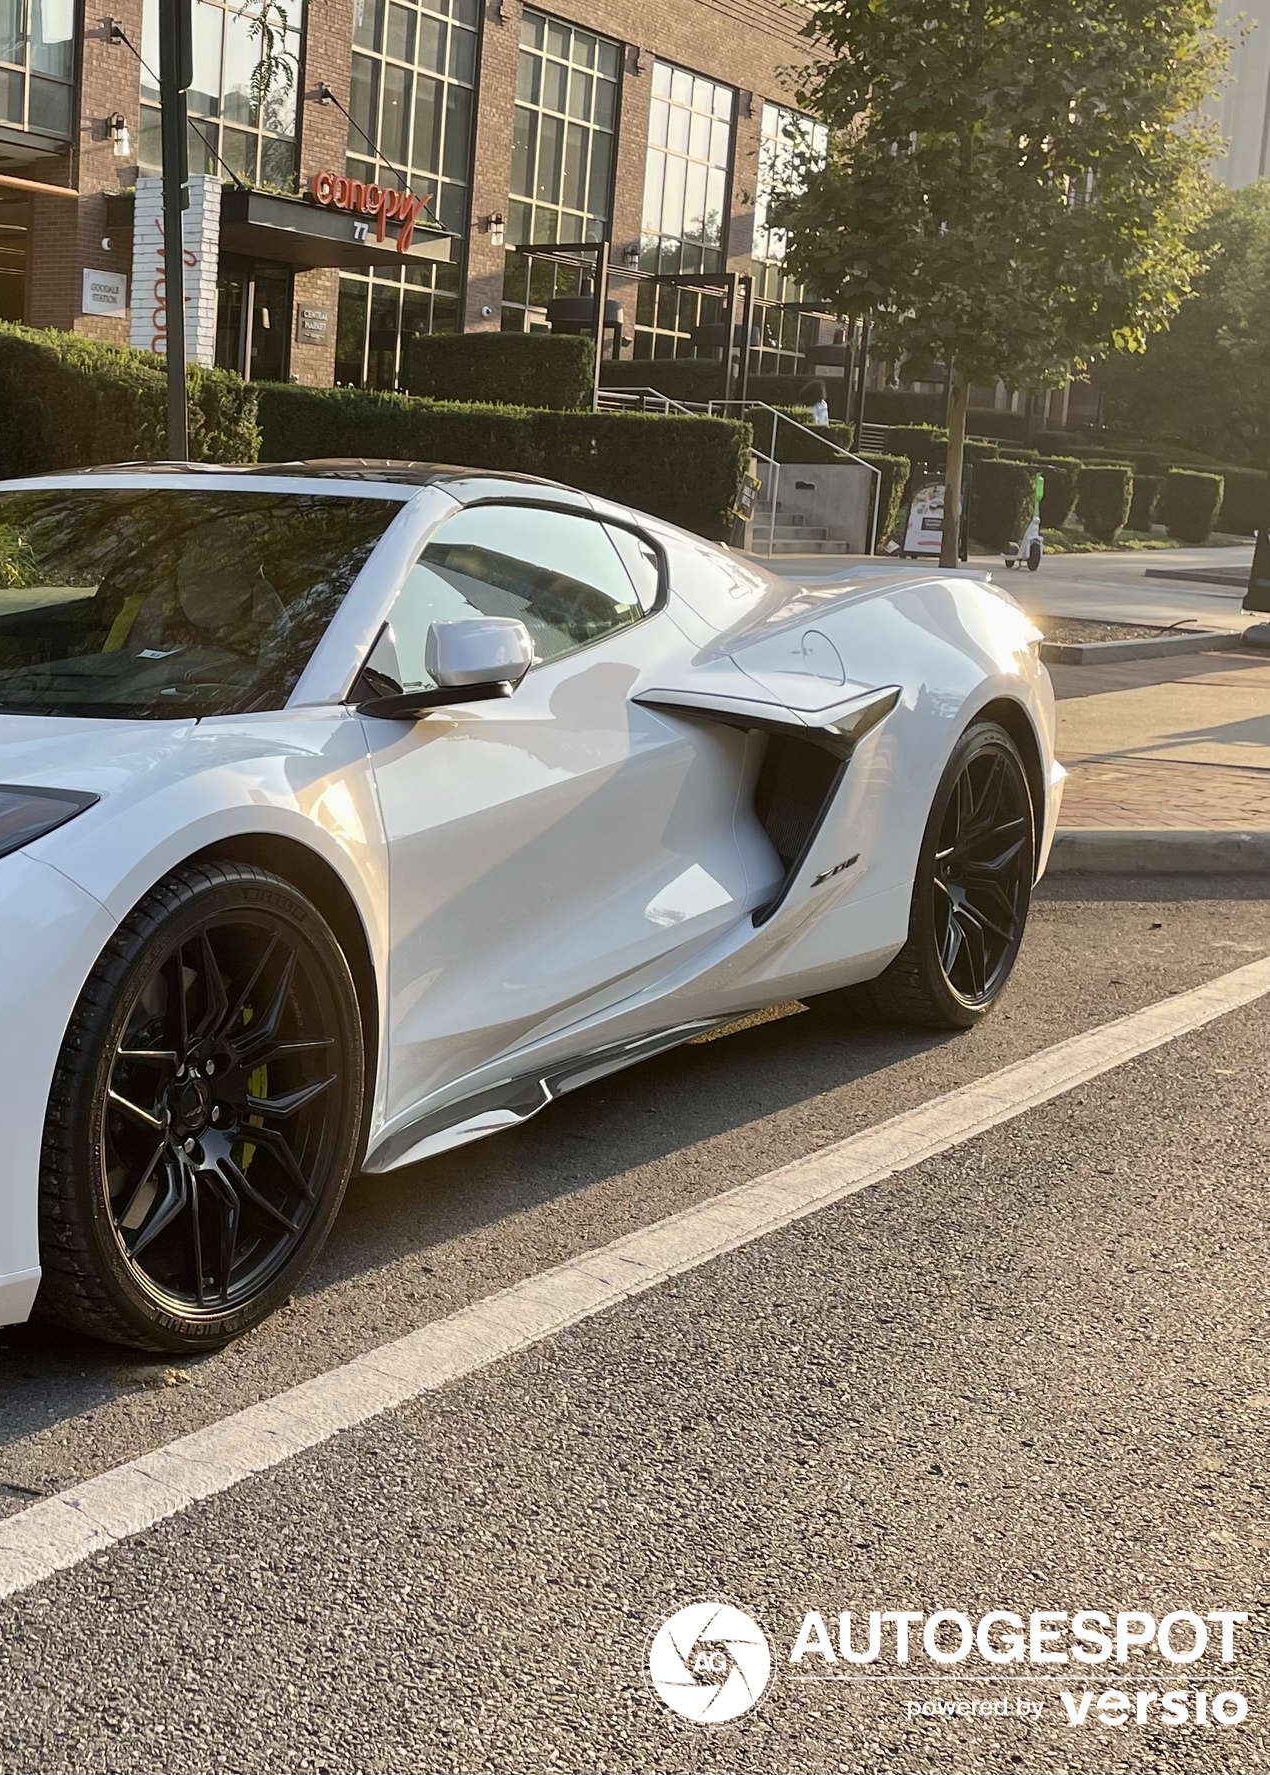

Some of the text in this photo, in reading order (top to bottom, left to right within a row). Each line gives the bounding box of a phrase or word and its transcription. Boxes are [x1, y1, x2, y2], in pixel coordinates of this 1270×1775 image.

[312, 170, 433, 252] canopy
[353, 220, 369, 241] 77
[92, 294, 118, 304] STATION
[304, 320, 327, 331] MARKET
[157, 1311, 221, 1337] MICHELIN
